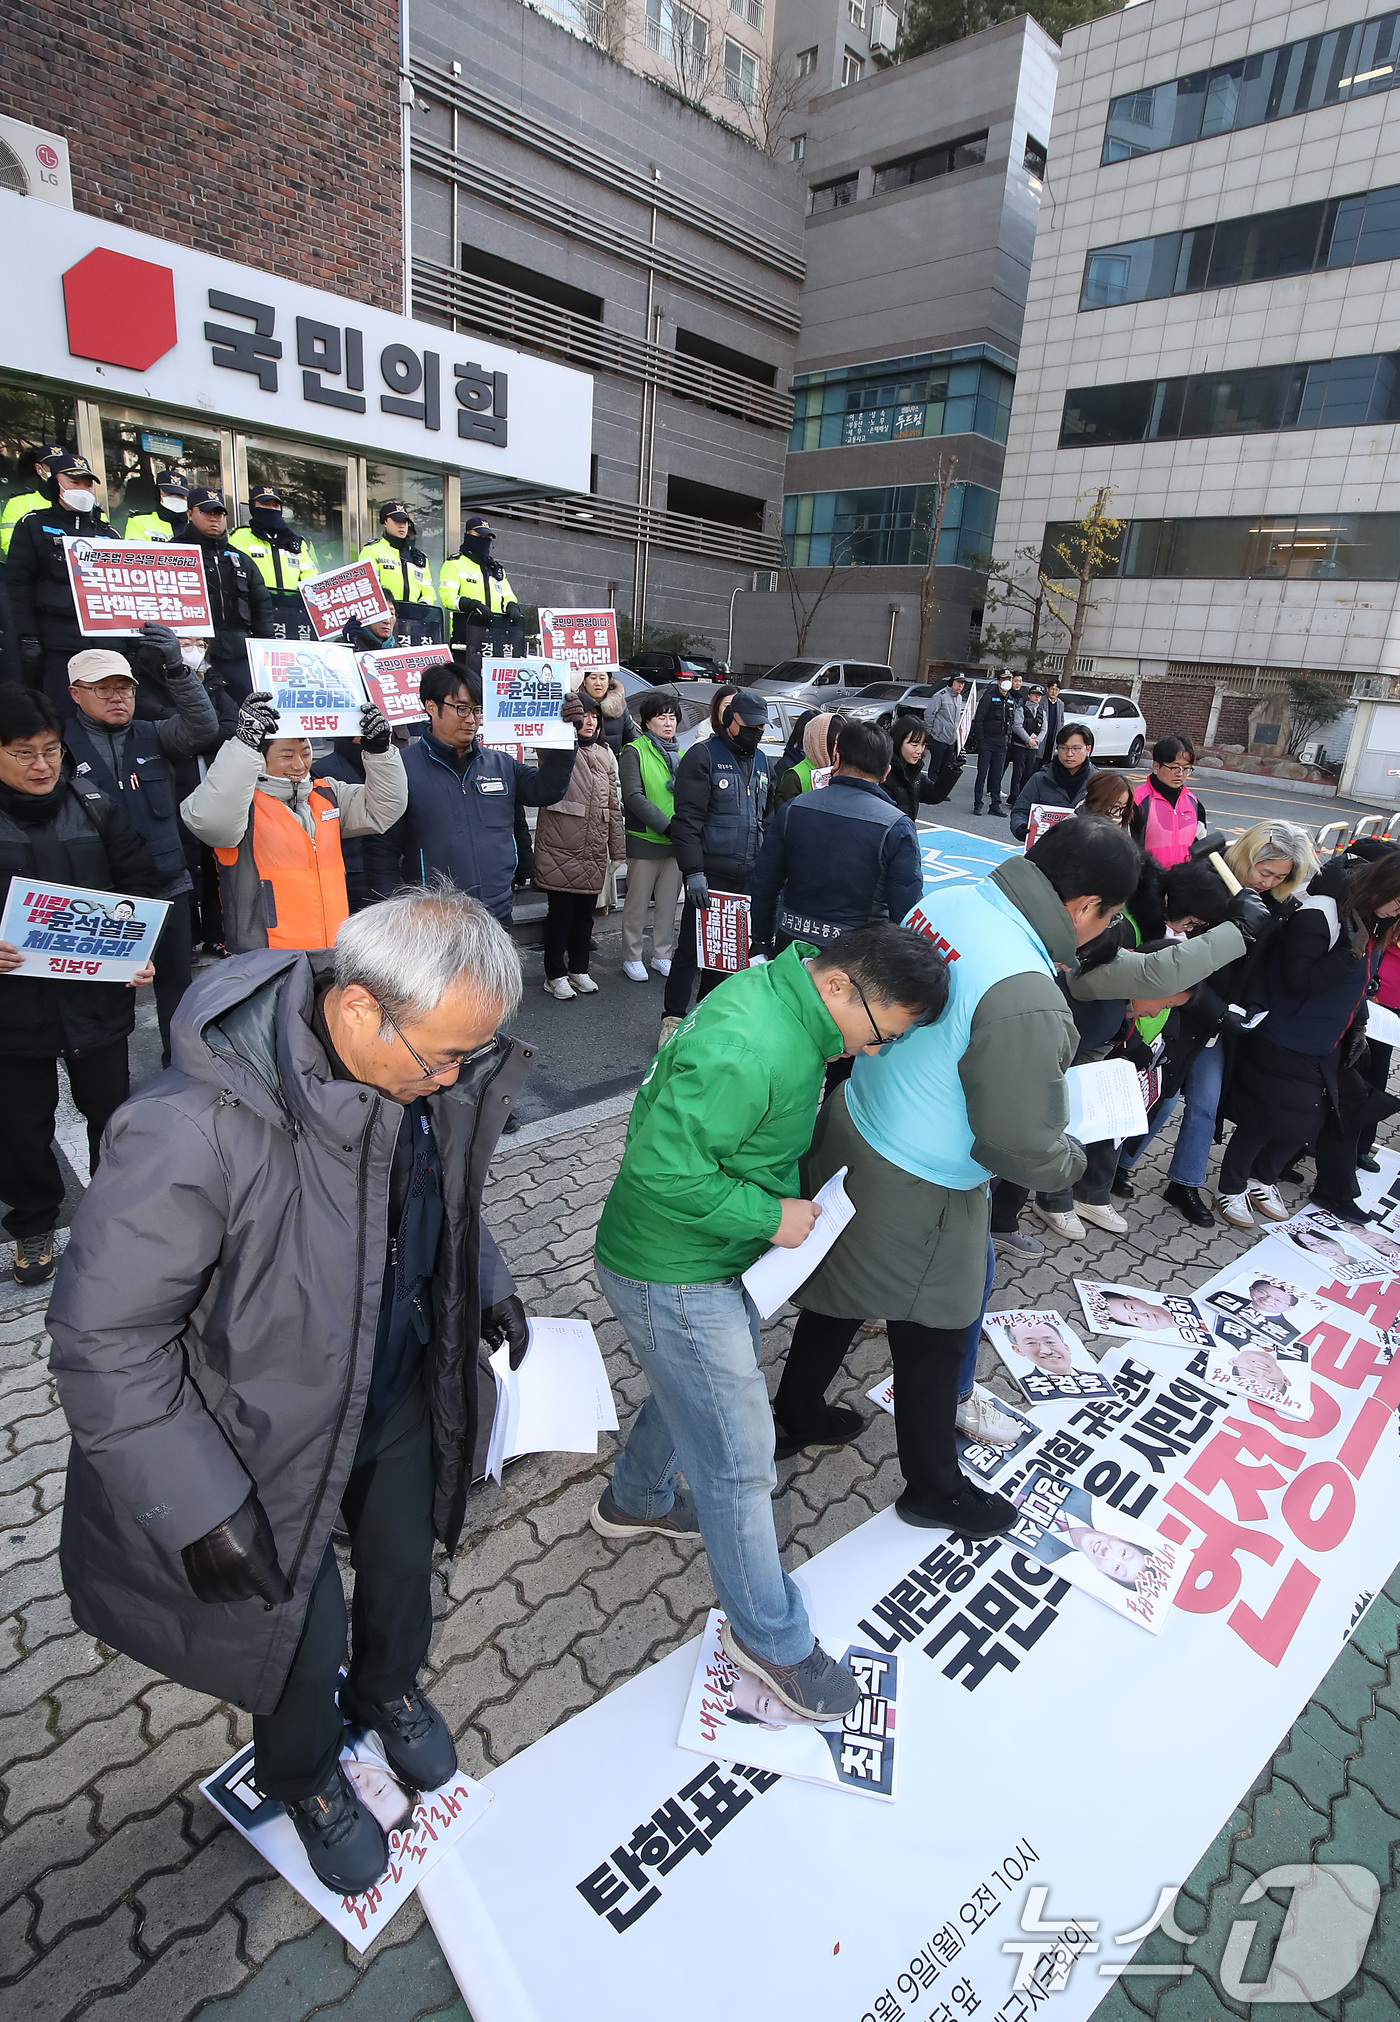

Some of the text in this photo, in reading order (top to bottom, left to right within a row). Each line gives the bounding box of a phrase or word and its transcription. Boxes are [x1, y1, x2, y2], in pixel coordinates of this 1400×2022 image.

[40, 170, 58, 186] LG
[204, 288, 508, 448] 국민의힘
[896, 412, 922, 430] 두드림
[79, 551, 197, 567] 내란주범 윤석열 탄핵하라
[81, 567, 202, 595] 국민의힘은
[315, 577, 374, 611] 윤석열을
[85, 594, 206, 621] 탄핵동참하라
[552, 617, 610, 627] 국민의 명령이다!
[263, 651, 295, 666] 내란
[374, 659, 405, 672] 국민의
[492, 669, 517, 681] 내란
[277, 689, 356, 708] 체포하라!
[509, 681, 562, 700] 윤석열을
[497, 701, 559, 717] 체포하라!
[300, 716, 339, 730] 진보당
[514, 723, 544, 736] 진보당
[23, 892, 70, 911] 내란
[47, 910, 147, 941] 윤석열을
[722, 900, 737, 970] 국민의힘은
[22, 930, 136, 957] 체포하라!
[48, 957, 102, 976] 진보당
[986, 1312, 1062, 1328] 내란동조범
[1162, 1294, 1210, 1346] 유영하
[1025, 1372, 1108, 1396] 추경호
[1120, 1377, 1230, 1474] 시민의
[1007, 1476, 1073, 1549] 강대식
[1126, 1543, 1176, 1623] 내란동조범
[840, 1654, 890, 1784] 최은석
[576, 1760, 782, 1934] 탄핵표
[897, 1921, 966, 2003] 9일(월)
[959, 1882, 1001, 1935] 오전
[993, 1838, 1041, 1892] 10시
[951, 1977, 982, 2017] 앞
